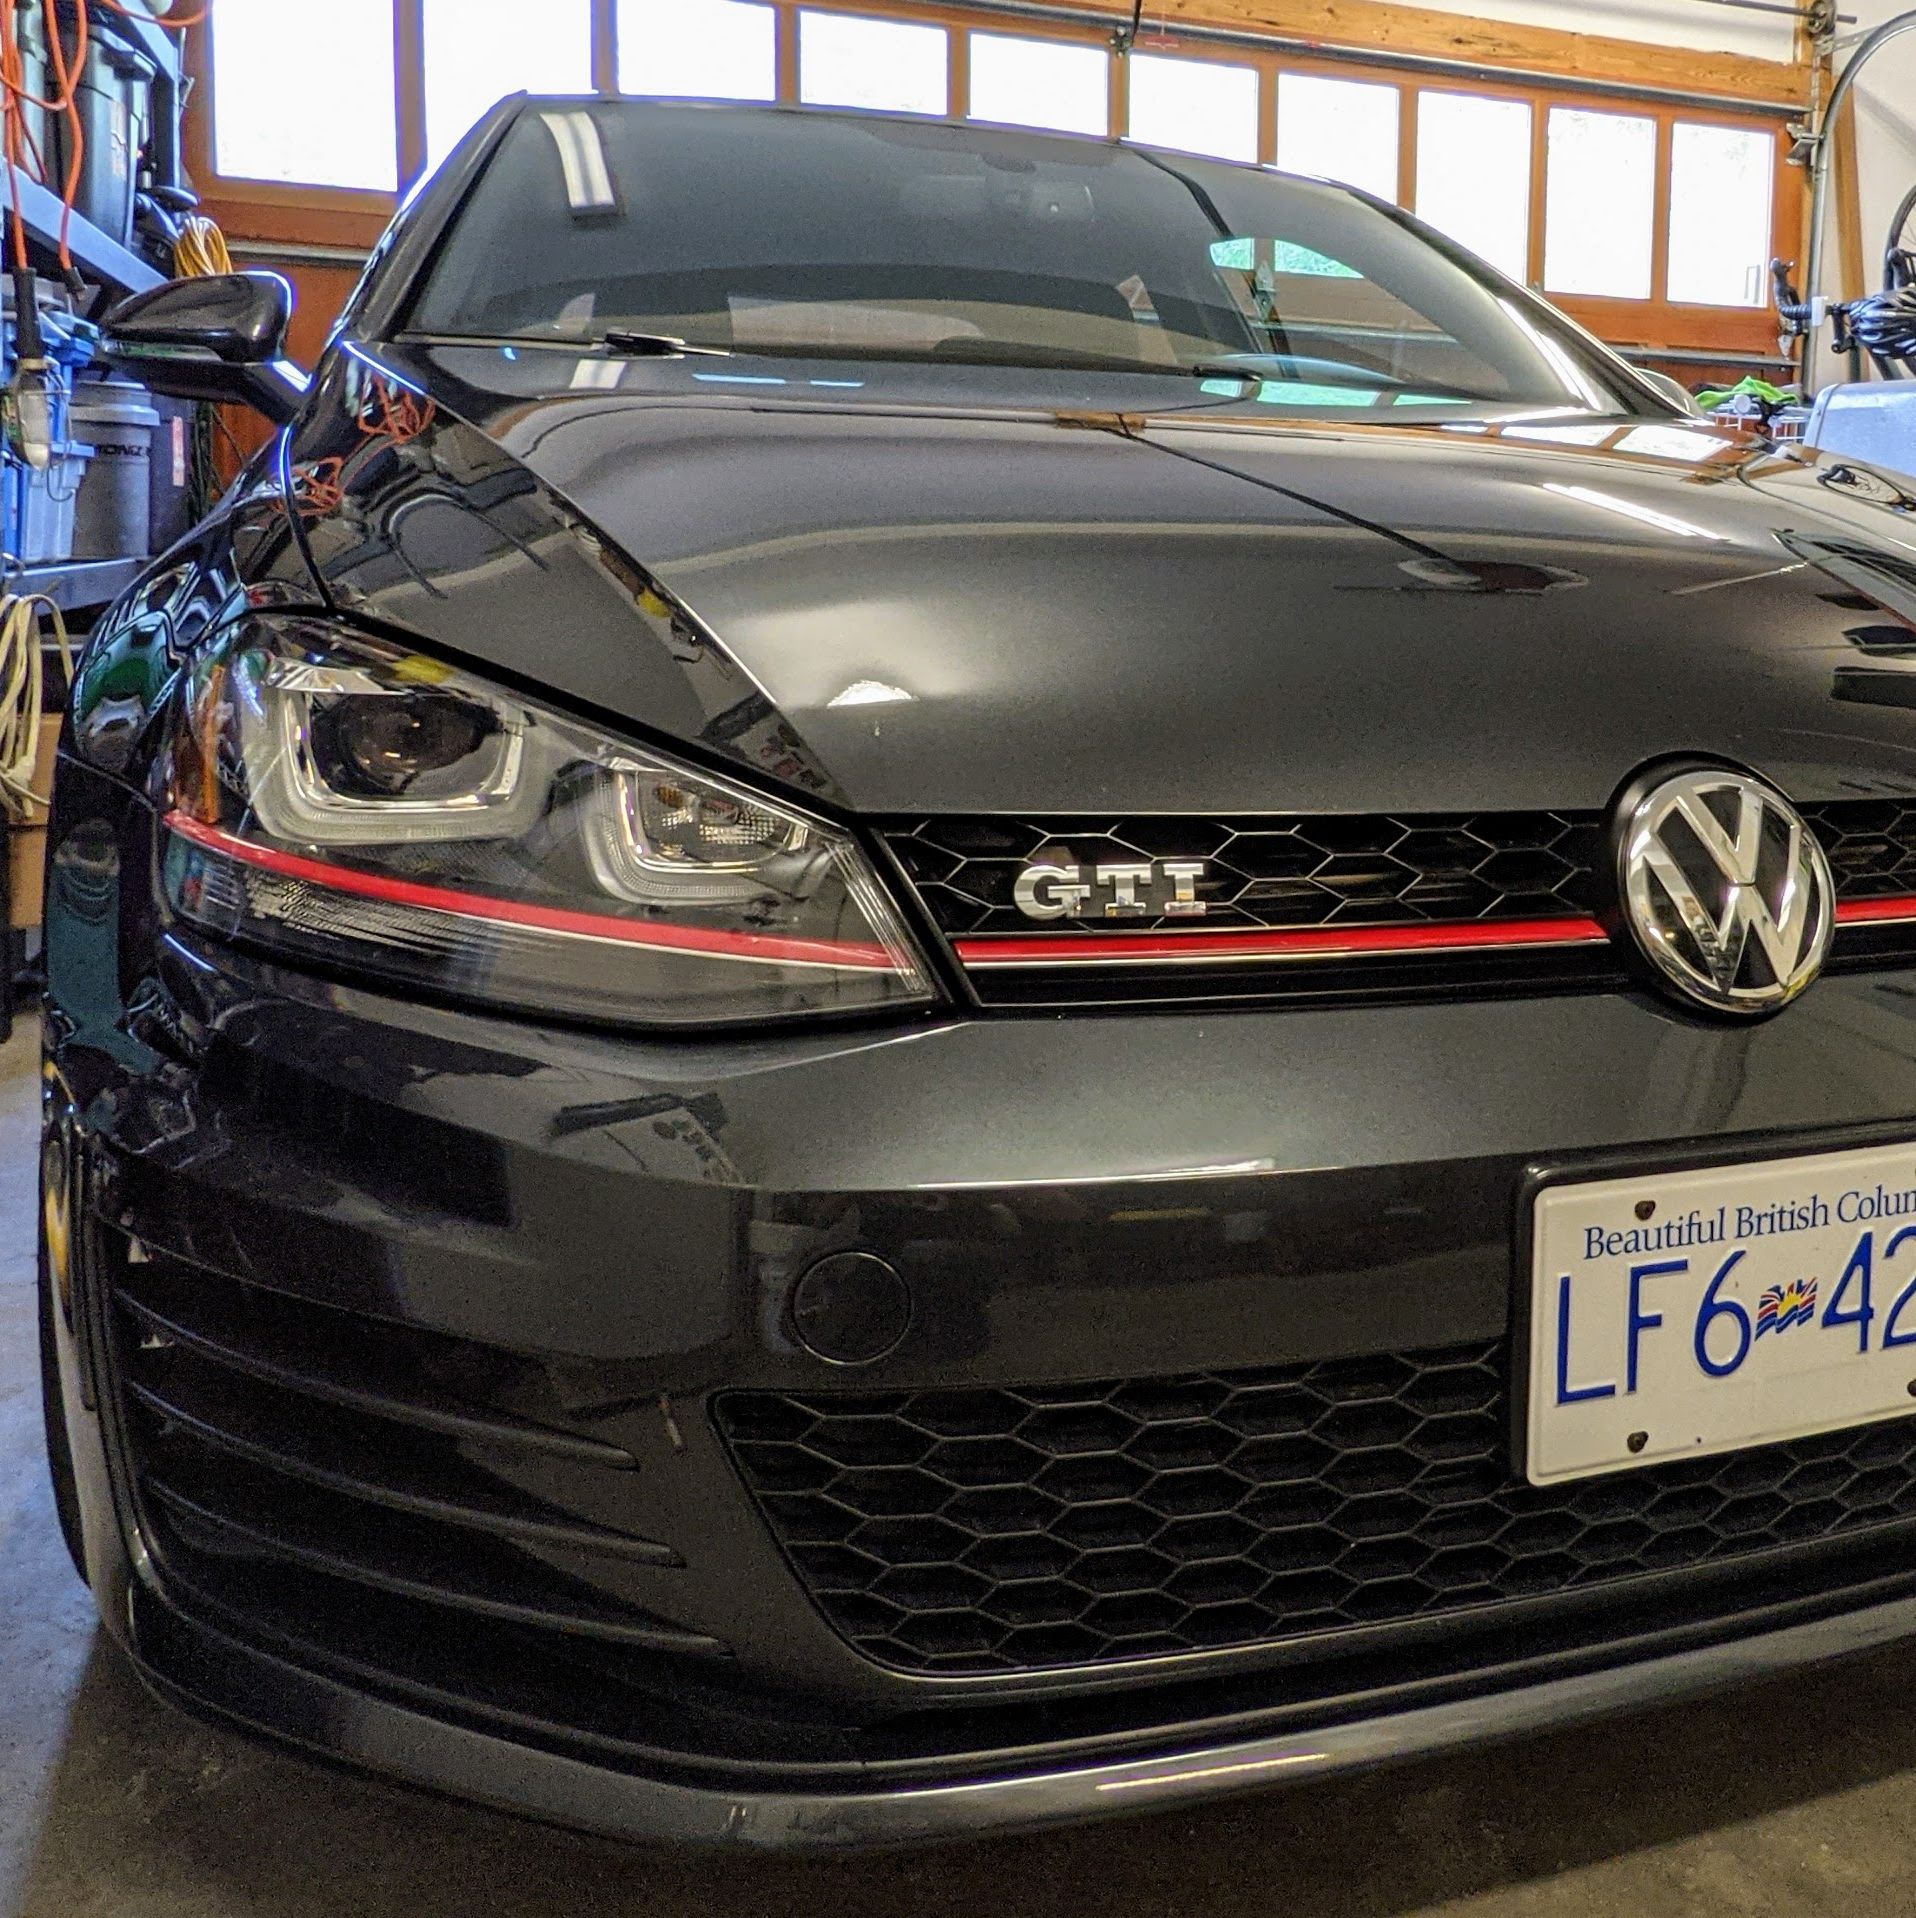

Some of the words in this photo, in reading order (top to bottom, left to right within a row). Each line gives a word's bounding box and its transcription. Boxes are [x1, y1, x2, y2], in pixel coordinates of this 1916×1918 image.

[1013, 863, 1207, 920] GTI
[1583, 1206, 1726, 1260] Beautiful
[1735, 1194, 1829, 1240] British
